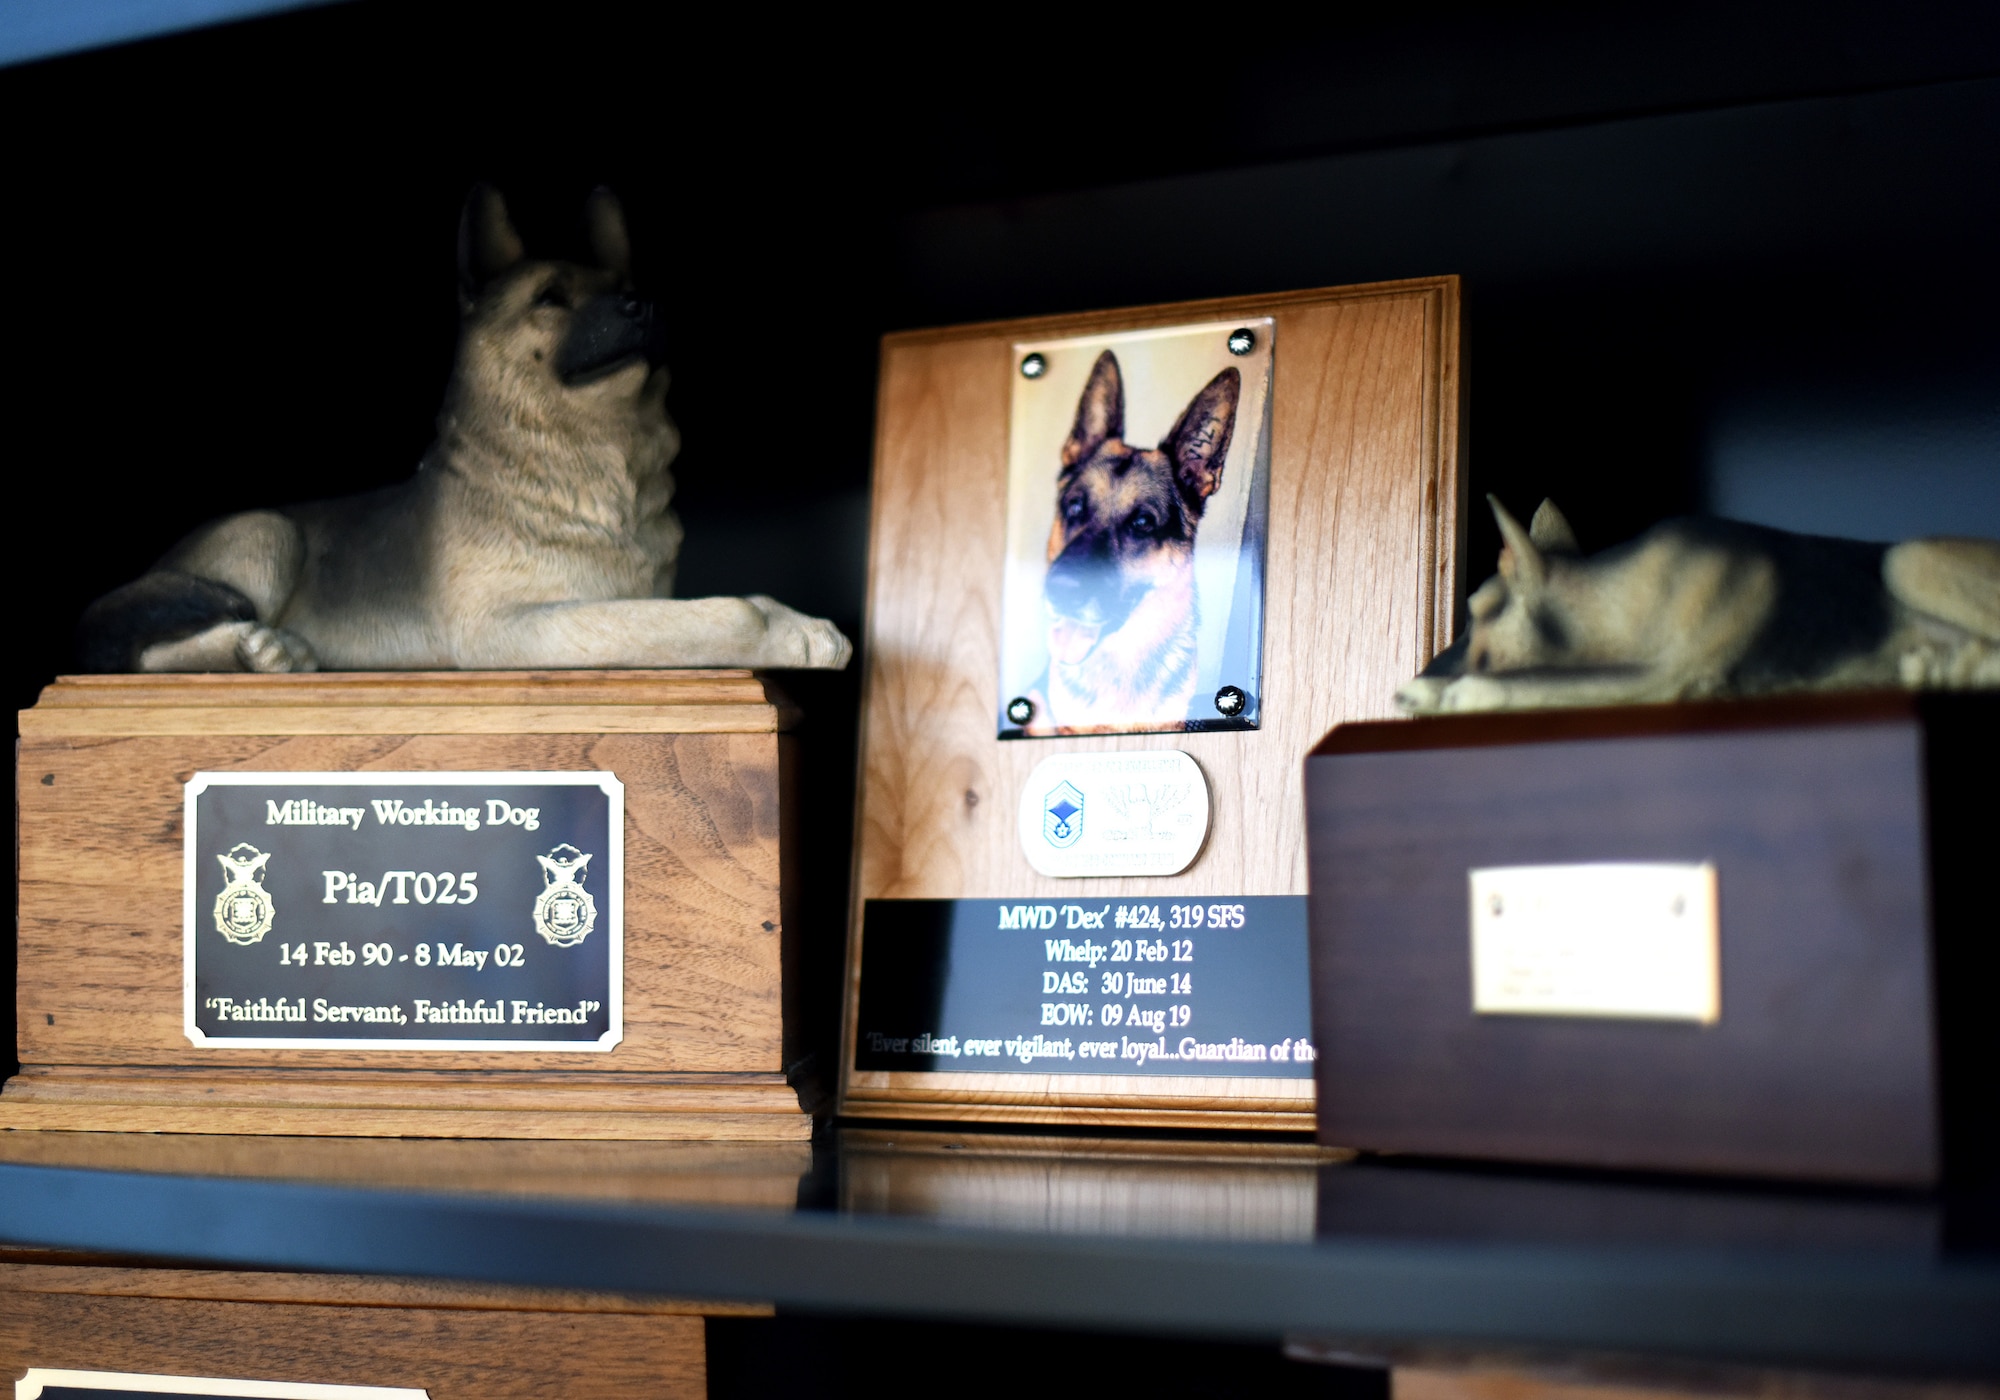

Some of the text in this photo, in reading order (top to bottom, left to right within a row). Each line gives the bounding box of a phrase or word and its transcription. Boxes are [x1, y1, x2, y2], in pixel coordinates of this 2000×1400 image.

[266, 799, 539, 831] Military Working Dog
[323, 871, 477, 907] Pia/T025
[999, 906, 1057, 929] MWD
[1115, 905, 1165, 931] #424,
[1170, 905, 1204, 928] 319
[1208, 905, 1245, 928] SFS
[281, 943, 308, 966] 14
[314, 942, 355, 965] Feb
[362, 943, 393, 966] 90
[415, 943, 430, 966] 8
[437, 943, 488, 971] May
[495, 944, 525, 966] 02
[1045, 939, 1193, 968] Whelp: 20 Feb 12
[1043, 972, 1191, 998] DAS: 30 June 14
[207, 998, 600, 1025] “Faithful Servant, Faithful Friend”
[1041, 1003, 1191, 1034] EOW: 09 Aug 19
[913, 1033, 961, 1057] silent,
[964, 1039, 1002, 1056] ever
[1004, 1034, 1075, 1064] vigilant,
[1079, 1042, 1117, 1059] ever
[1270, 1038, 1291, 1062] of
